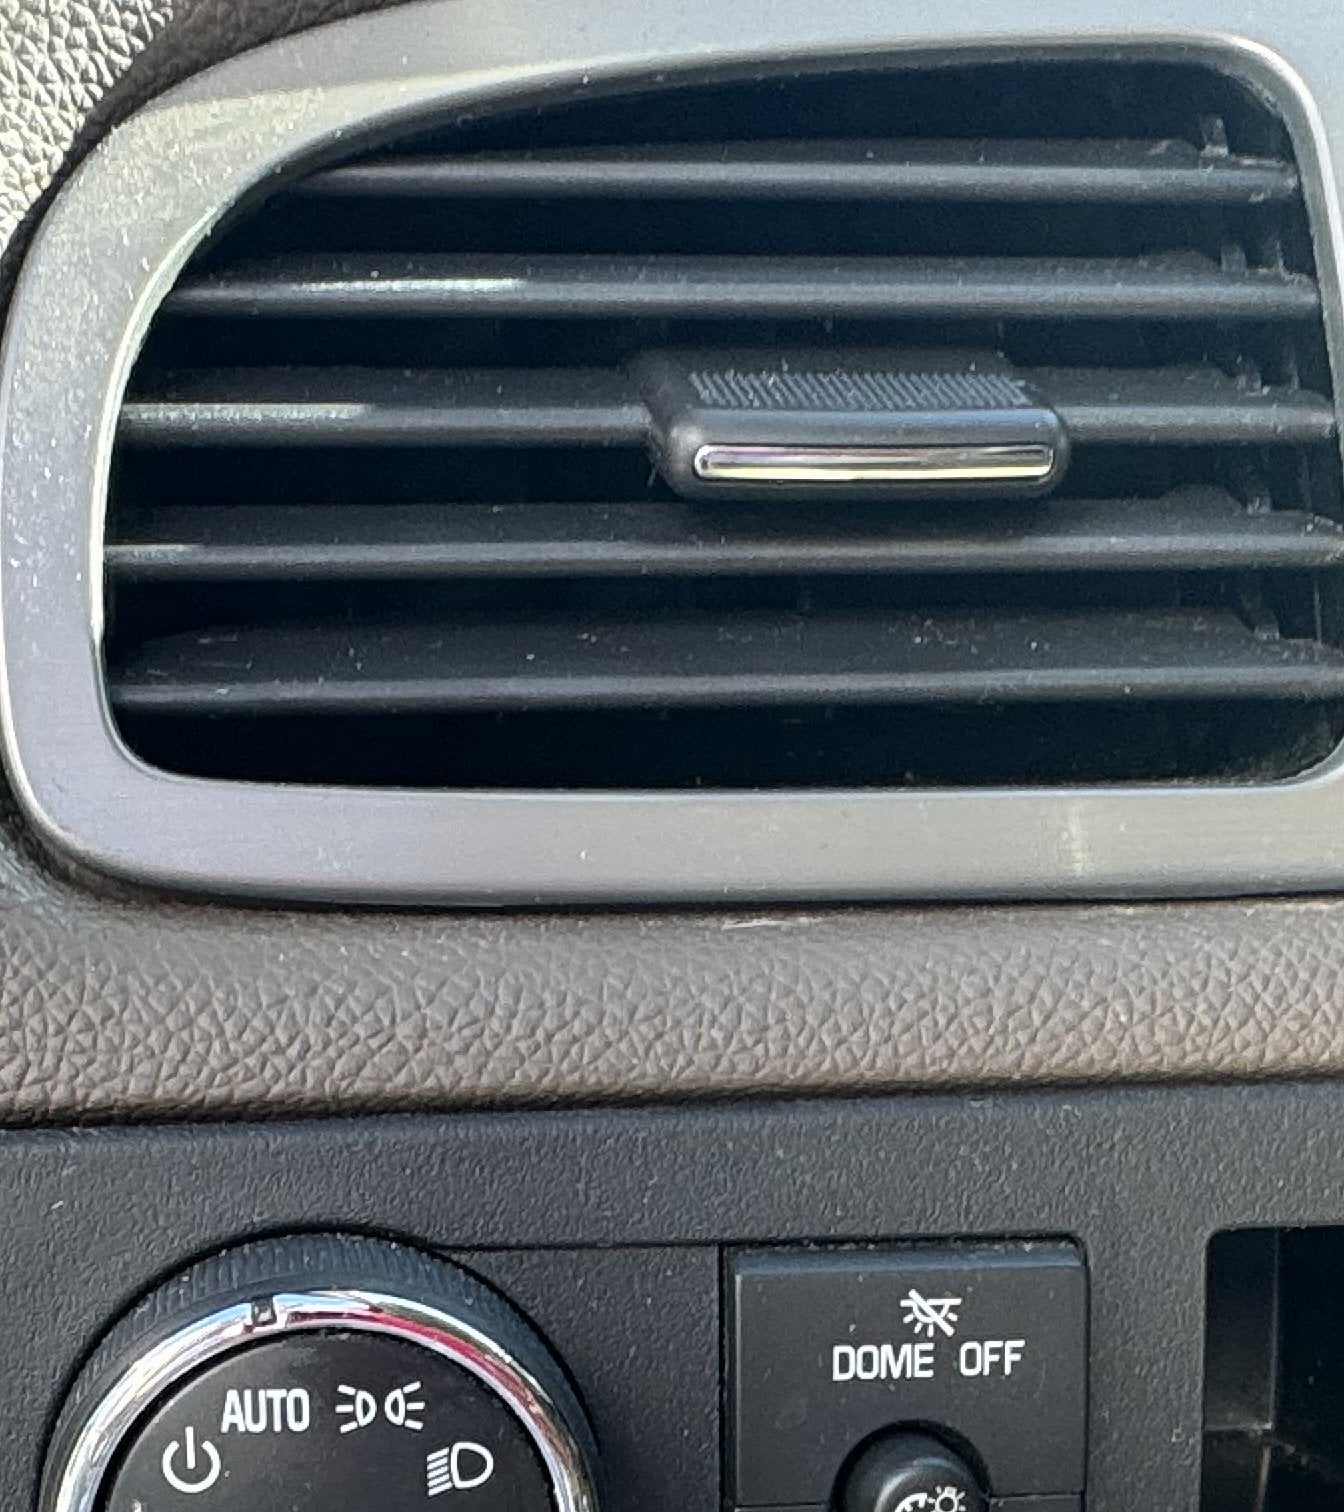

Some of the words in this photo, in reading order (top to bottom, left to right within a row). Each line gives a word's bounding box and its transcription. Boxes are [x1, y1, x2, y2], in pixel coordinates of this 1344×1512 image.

[831, 1341, 936, 1382] DOME
[958, 1338, 1026, 1378] OFF
[220, 1387, 310, 1434] AUTO
